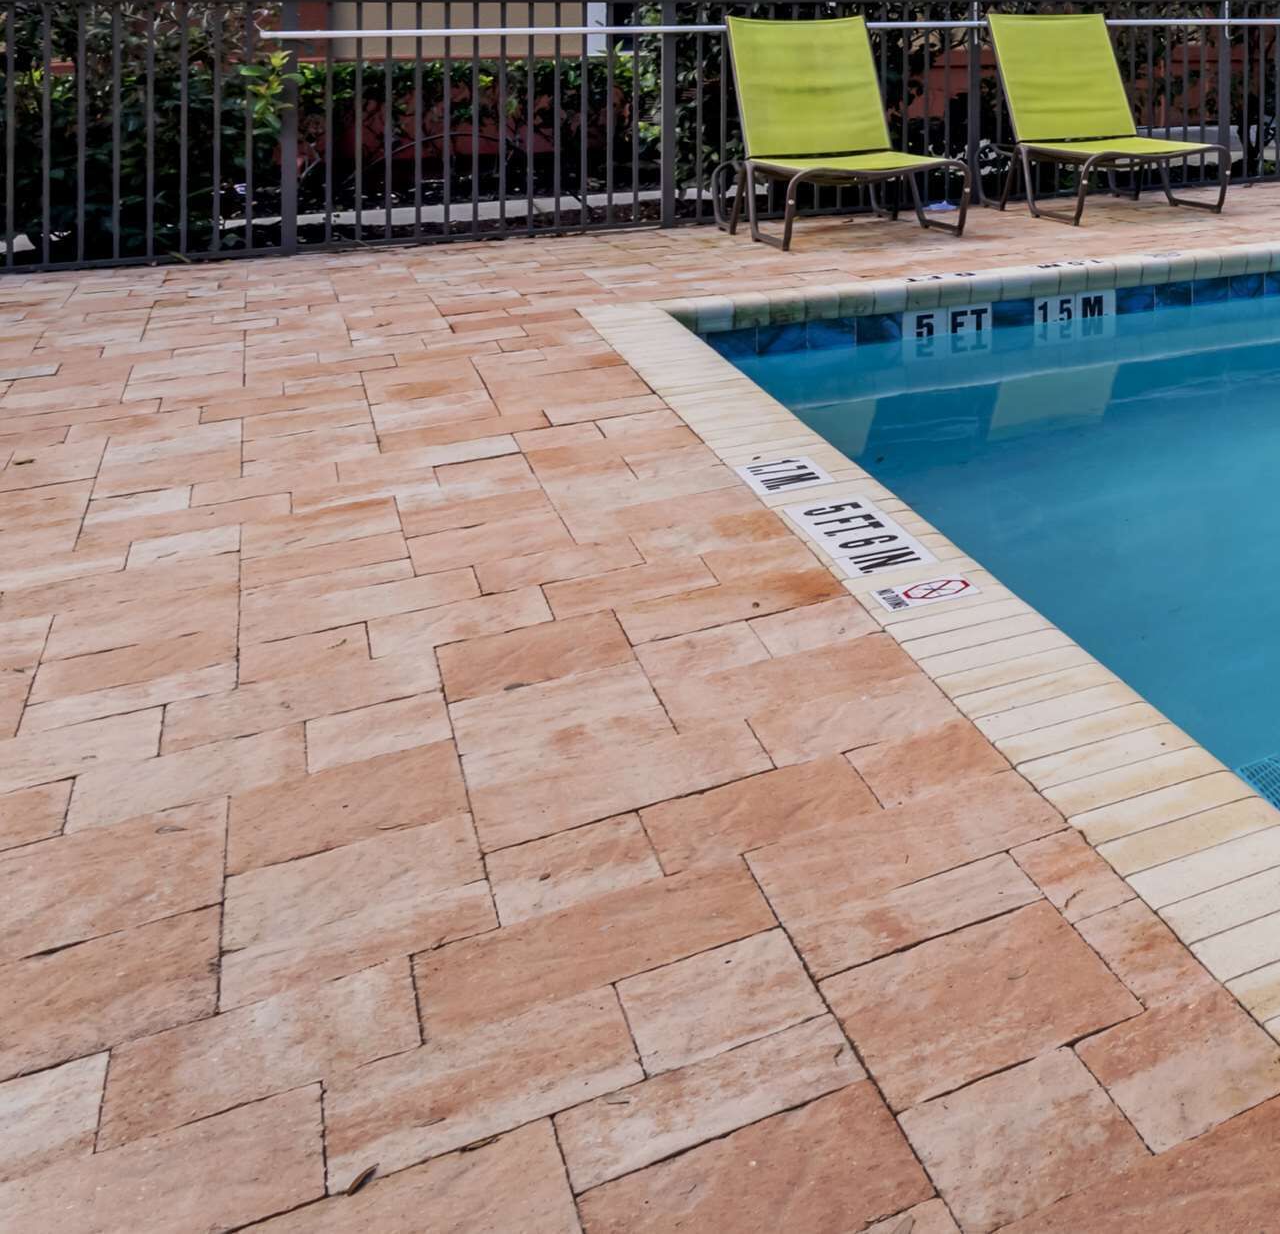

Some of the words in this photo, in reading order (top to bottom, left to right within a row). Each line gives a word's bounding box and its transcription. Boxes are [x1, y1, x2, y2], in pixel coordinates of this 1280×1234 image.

[916, 314, 934, 337] 5
[951, 308, 988, 333] FT
[804, 502, 862, 516] 5
[814, 514, 885, 537] FT.
[839, 534, 898, 549] 6
[849, 546, 921, 574] IN.
